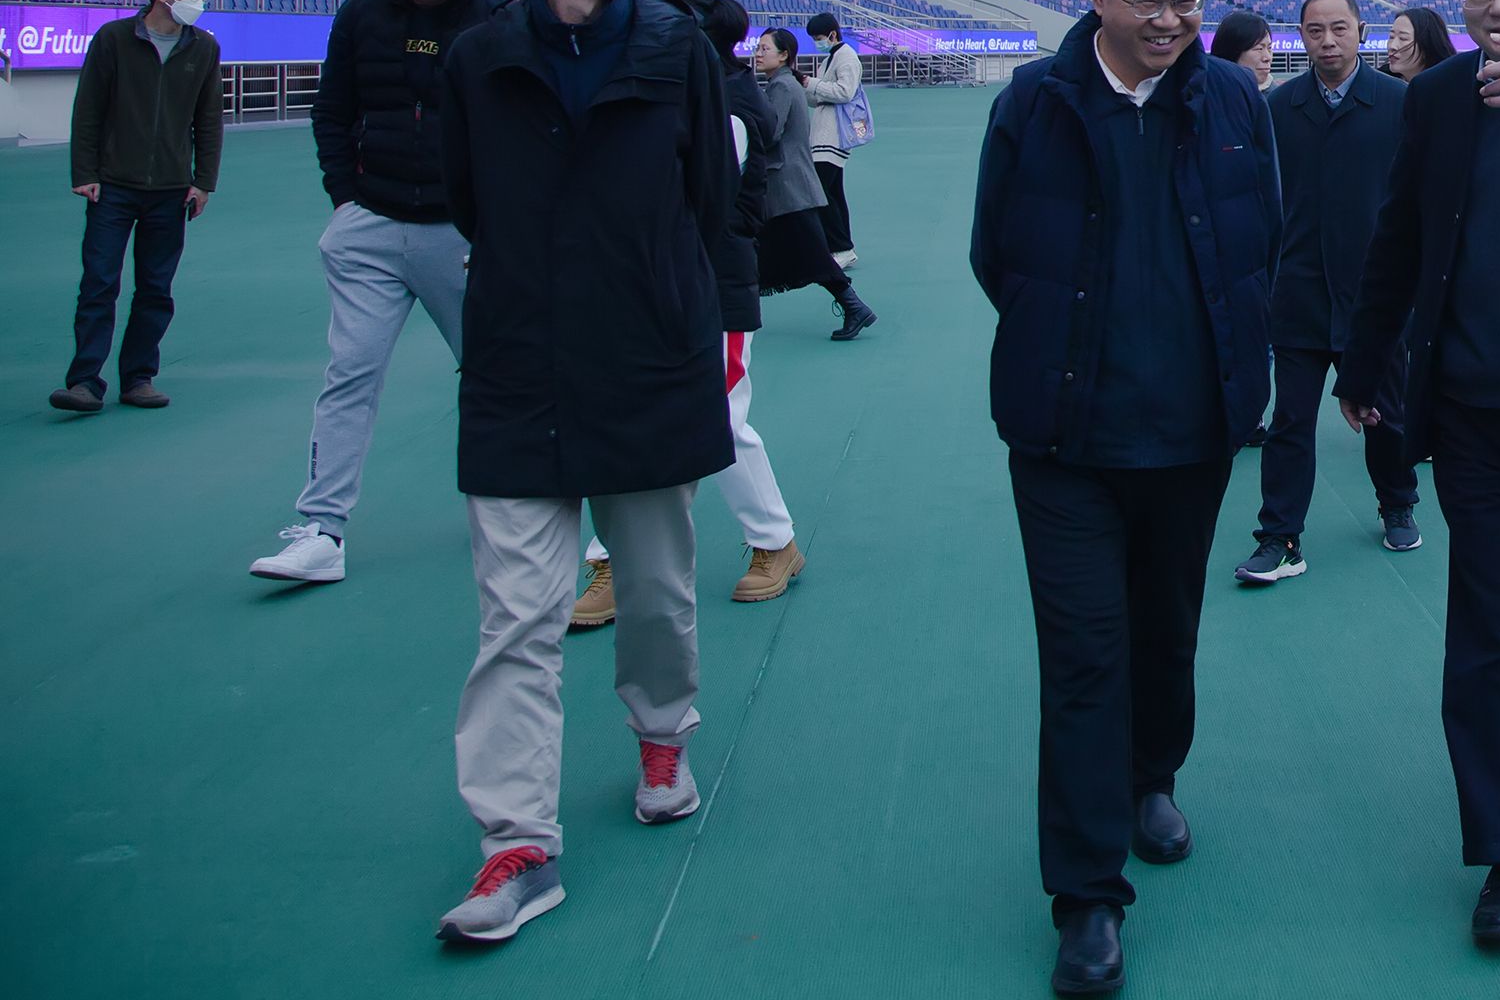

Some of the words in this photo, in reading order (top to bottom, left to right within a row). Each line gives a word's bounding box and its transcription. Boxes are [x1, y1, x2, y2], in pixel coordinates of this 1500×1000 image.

[18, 26, 94, 54] @Futur
[957, 38, 964, 50] to
[988, 38, 1020, 50] @Future
[1282, 39, 1292, 50] to
